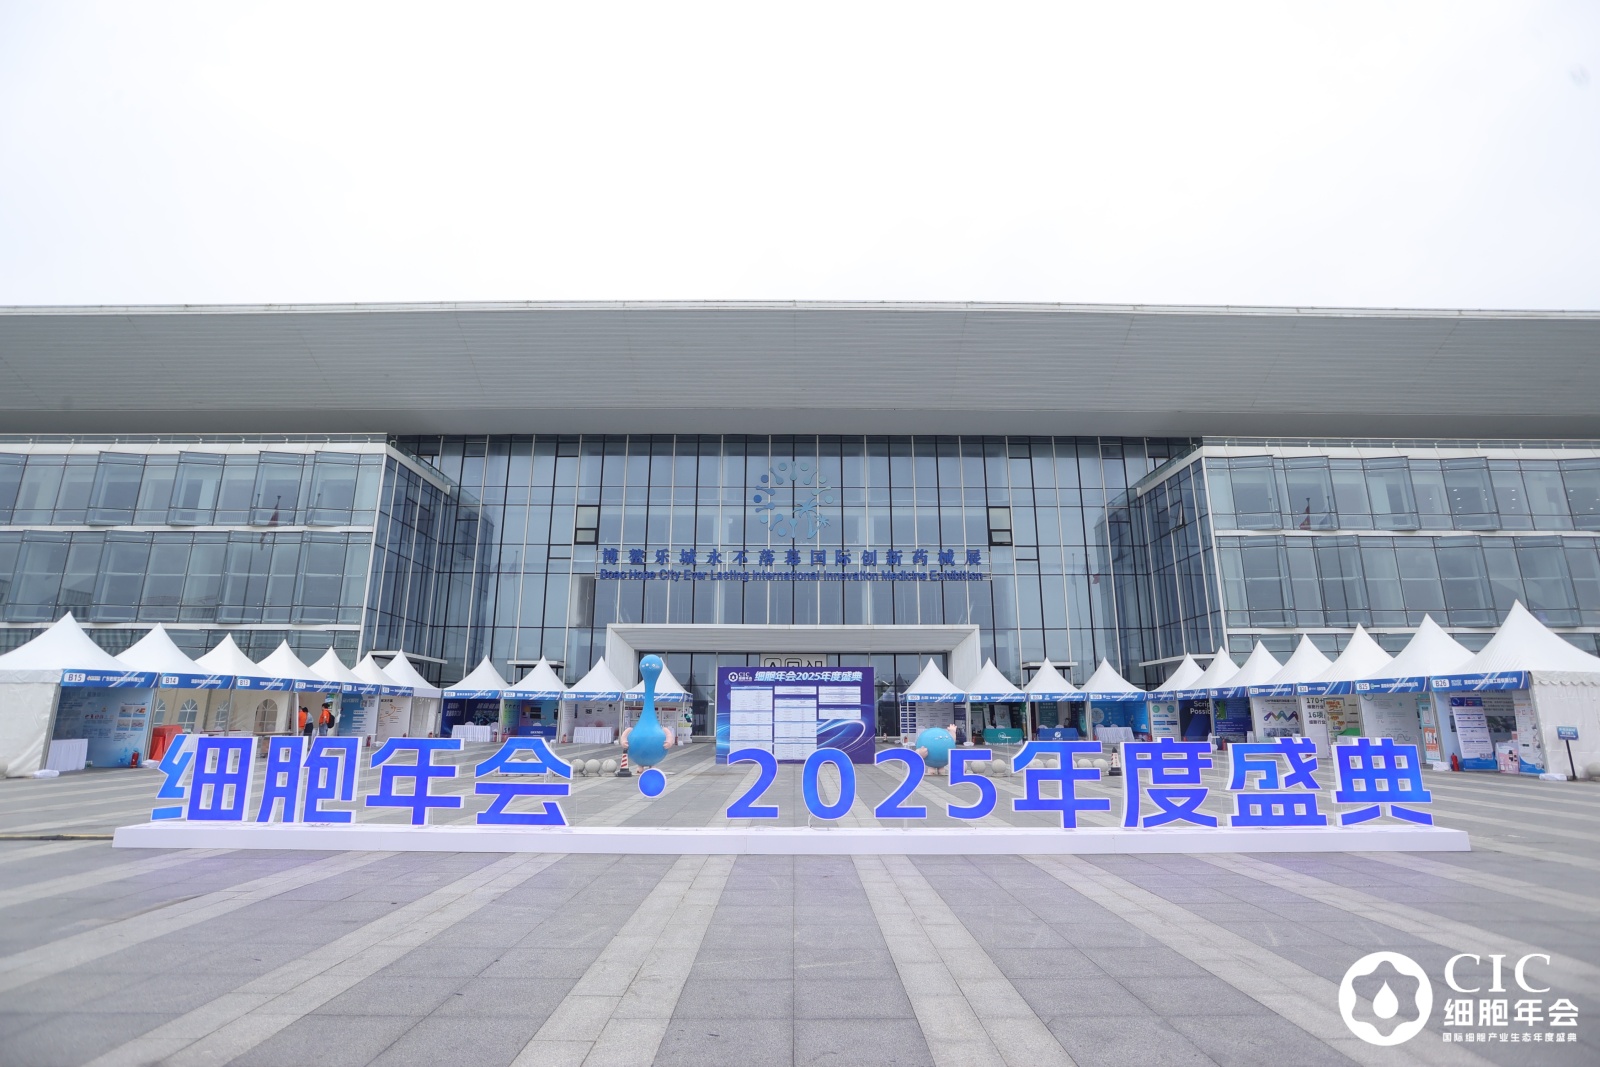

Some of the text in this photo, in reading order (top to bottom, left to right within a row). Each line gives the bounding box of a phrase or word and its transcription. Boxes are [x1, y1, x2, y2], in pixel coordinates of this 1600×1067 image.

[600, 569, 983, 582] Boao Hope City Ever Lasting International Innovation Medicine Exhibition
[68, 673, 82, 682] B15
[754, 671, 863, 682] 细胞年会2025年度盛典
